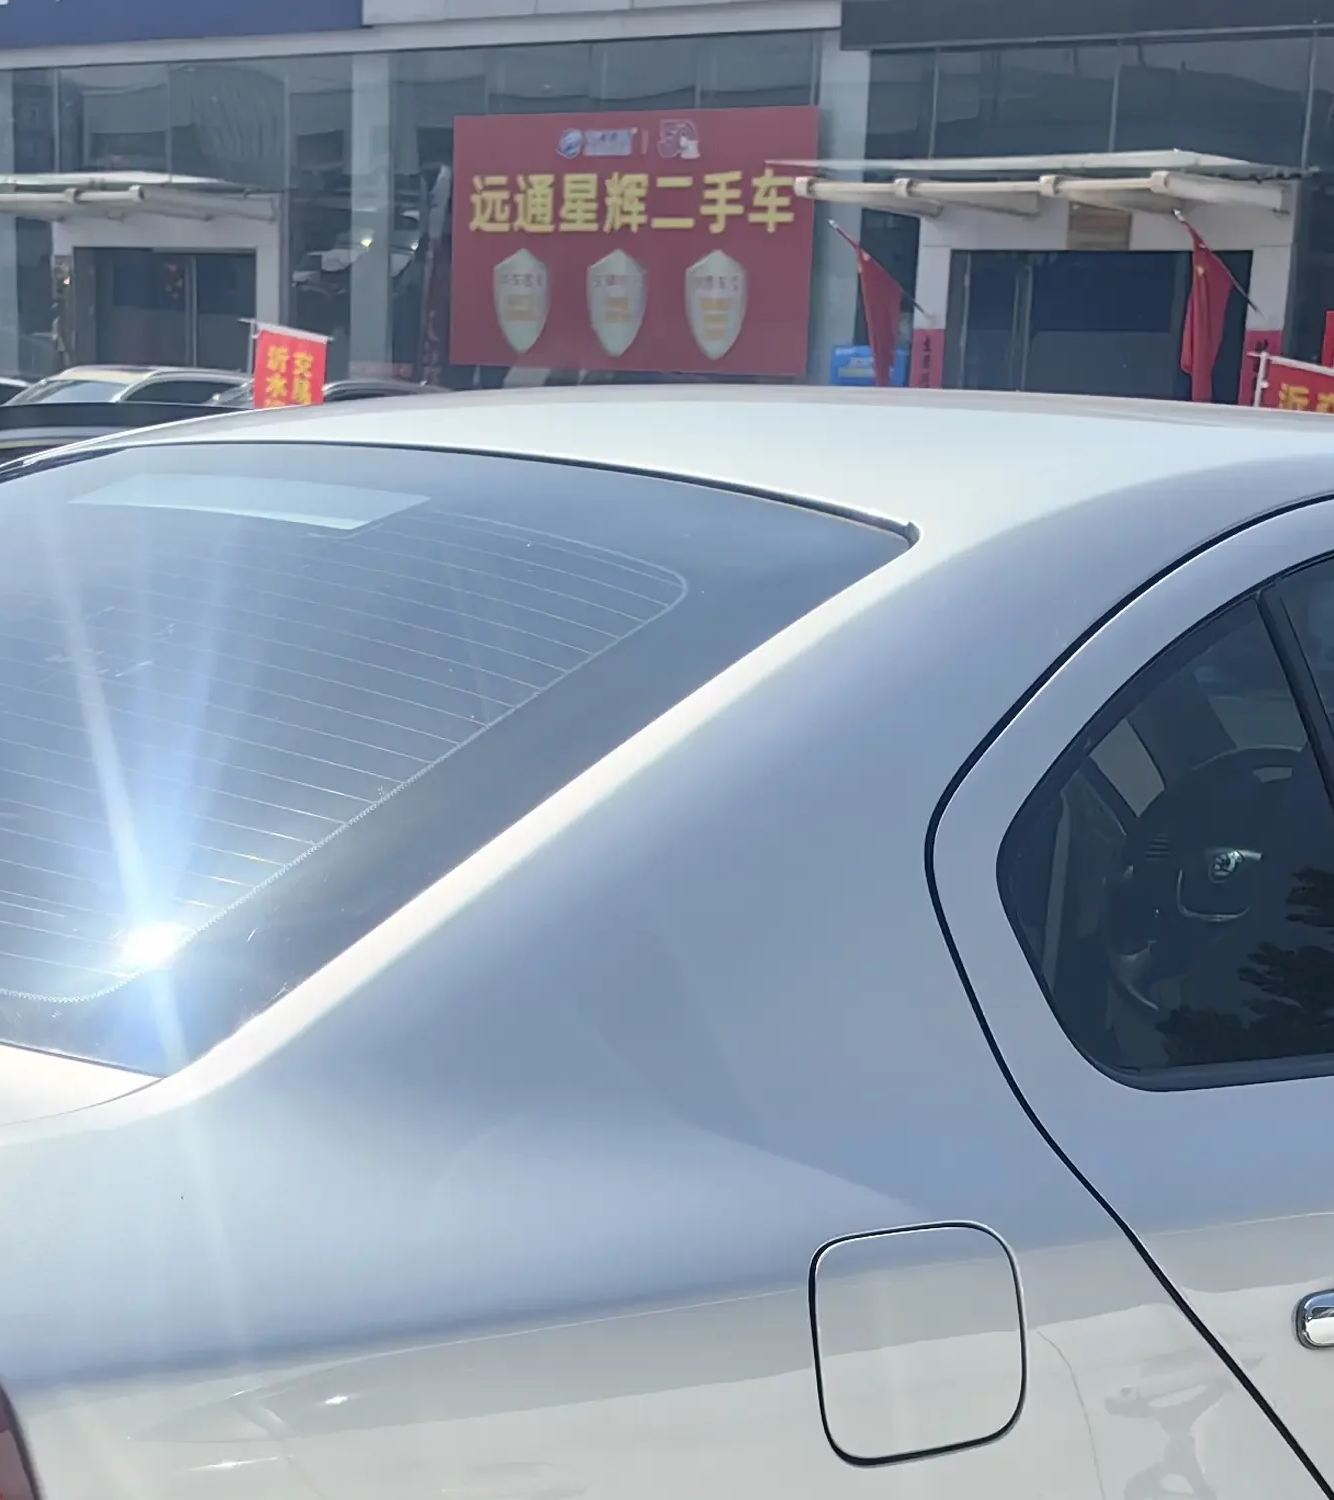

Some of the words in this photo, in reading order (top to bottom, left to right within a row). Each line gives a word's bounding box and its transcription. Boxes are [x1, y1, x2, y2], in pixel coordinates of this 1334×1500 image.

[469, 168, 795, 234] 远通星辉二手车
[264, 345, 290, 406] 沂水
